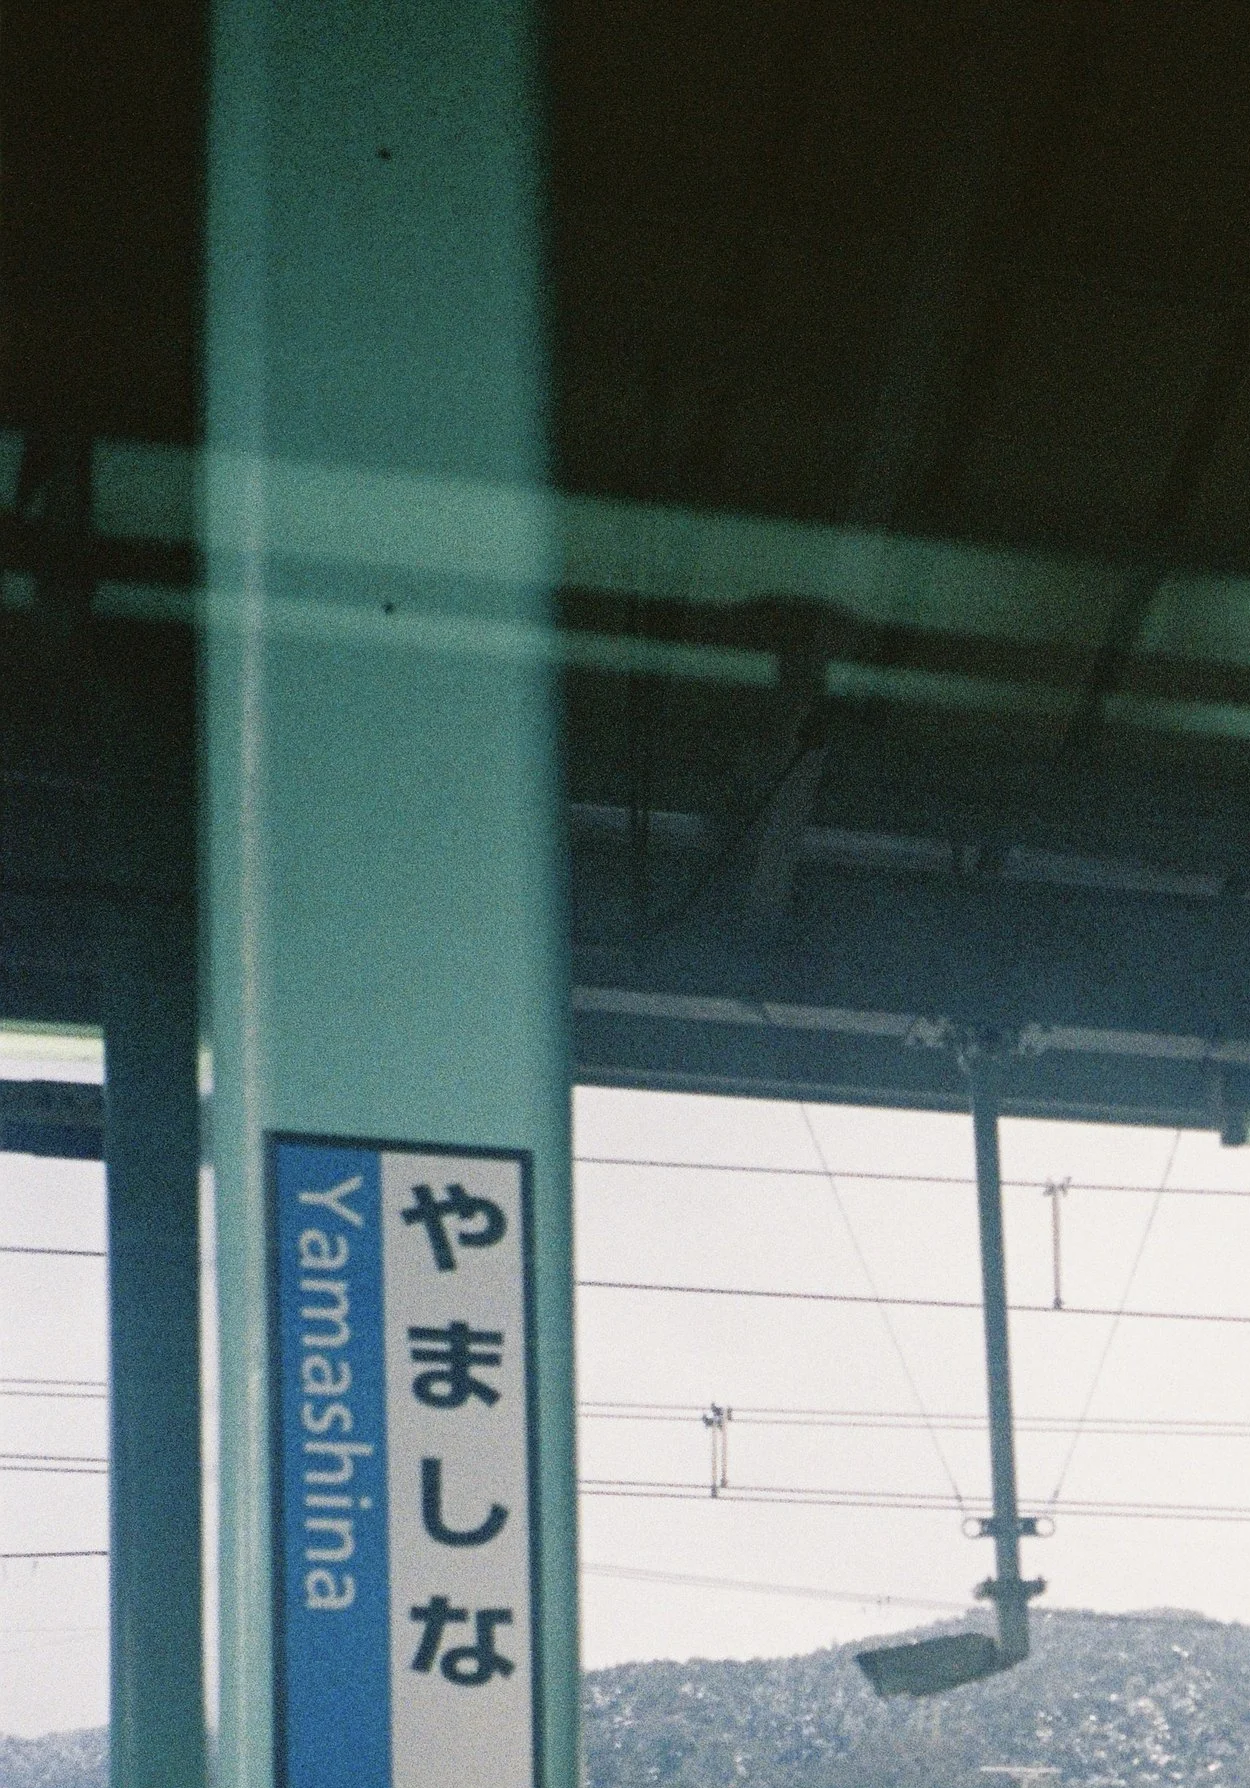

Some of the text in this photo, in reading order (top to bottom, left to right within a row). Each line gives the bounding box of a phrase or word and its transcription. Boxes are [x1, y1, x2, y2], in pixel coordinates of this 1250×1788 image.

[299, 1176, 372, 1611] Yamashina
[401, 1183, 516, 1687] やましな
